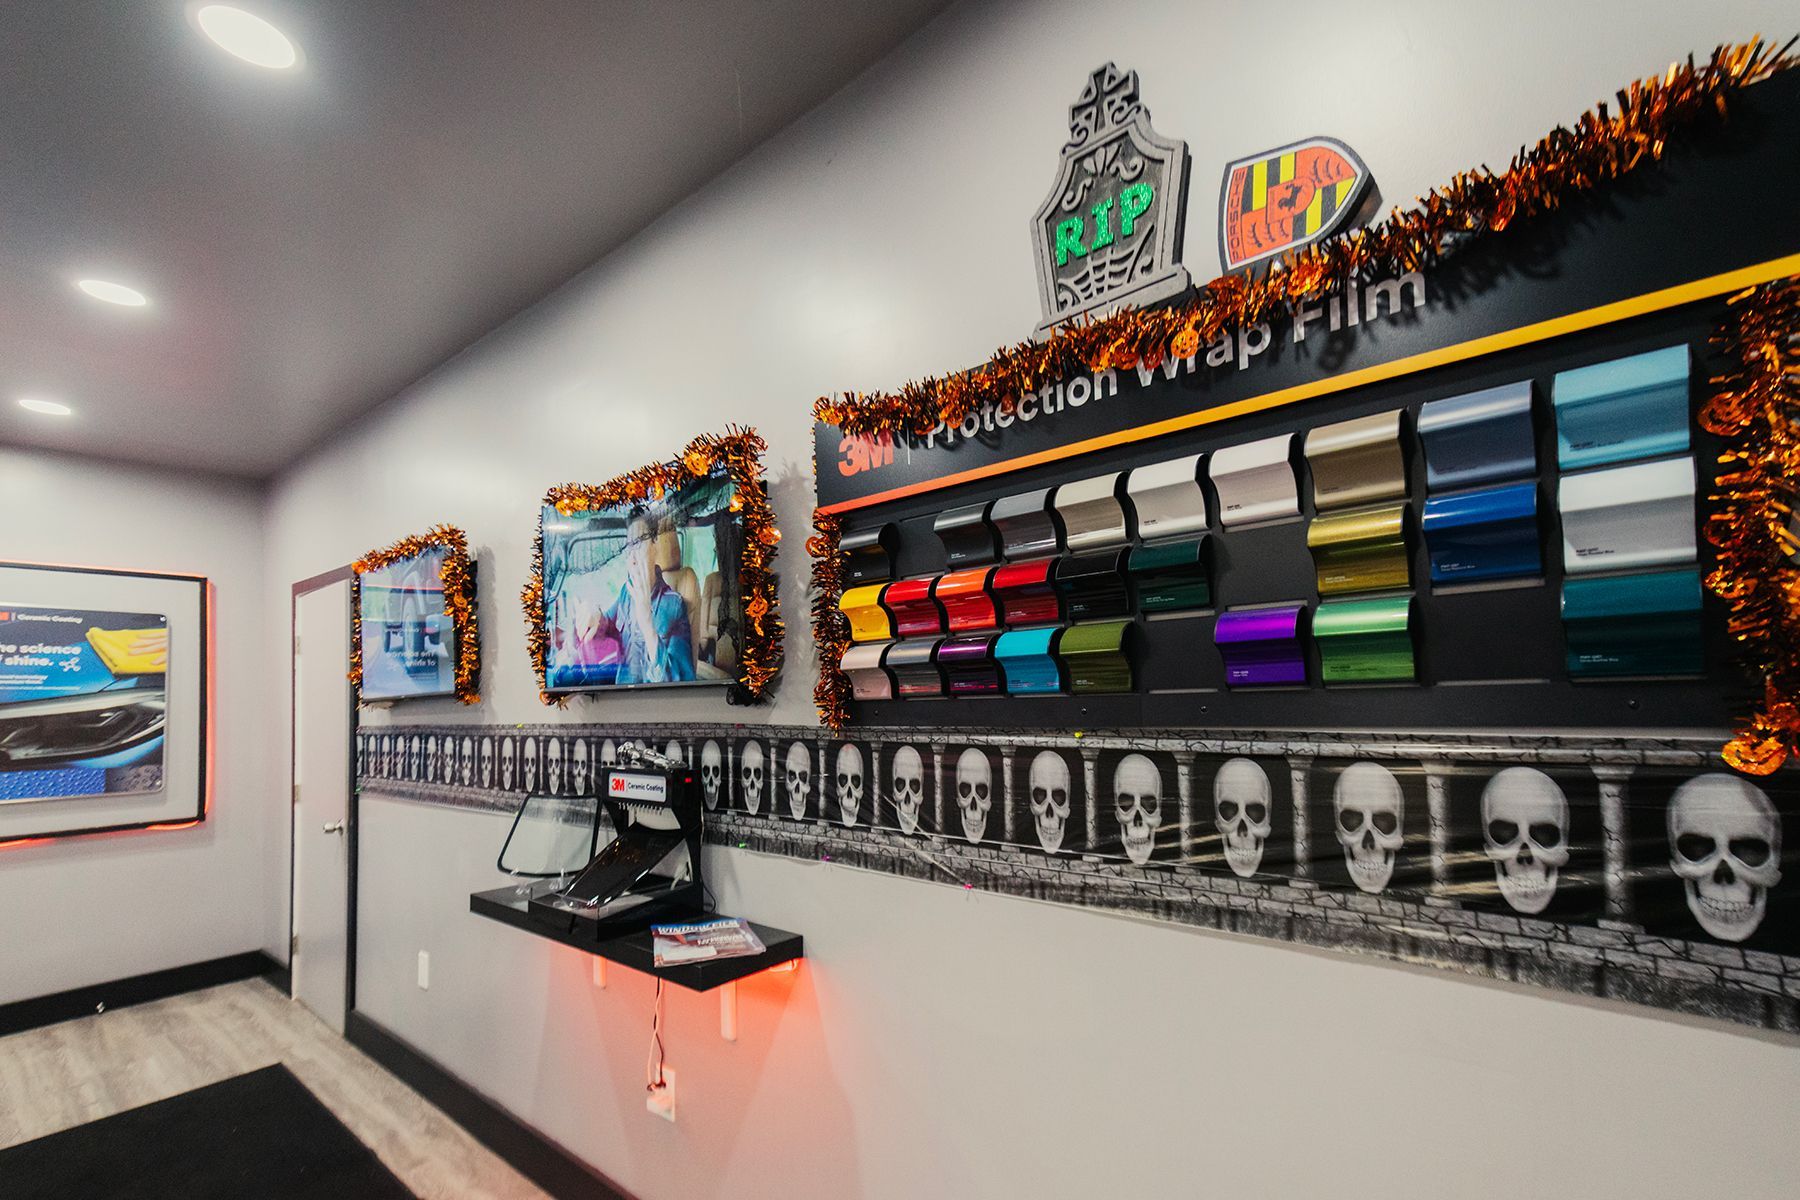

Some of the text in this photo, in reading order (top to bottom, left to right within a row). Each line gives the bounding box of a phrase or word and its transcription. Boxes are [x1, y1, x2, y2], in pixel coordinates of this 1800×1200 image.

[1056, 183, 1153, 267] RIP
[1229, 169, 1246, 262] PORSCHE
[838, 431, 894, 477] 3M
[1293, 270, 1426, 344] Film
[0, 642, 83, 656] he science
[4, 655, 55, 667] shine.
[611, 778, 664, 794] 3M Ceramic Coating
